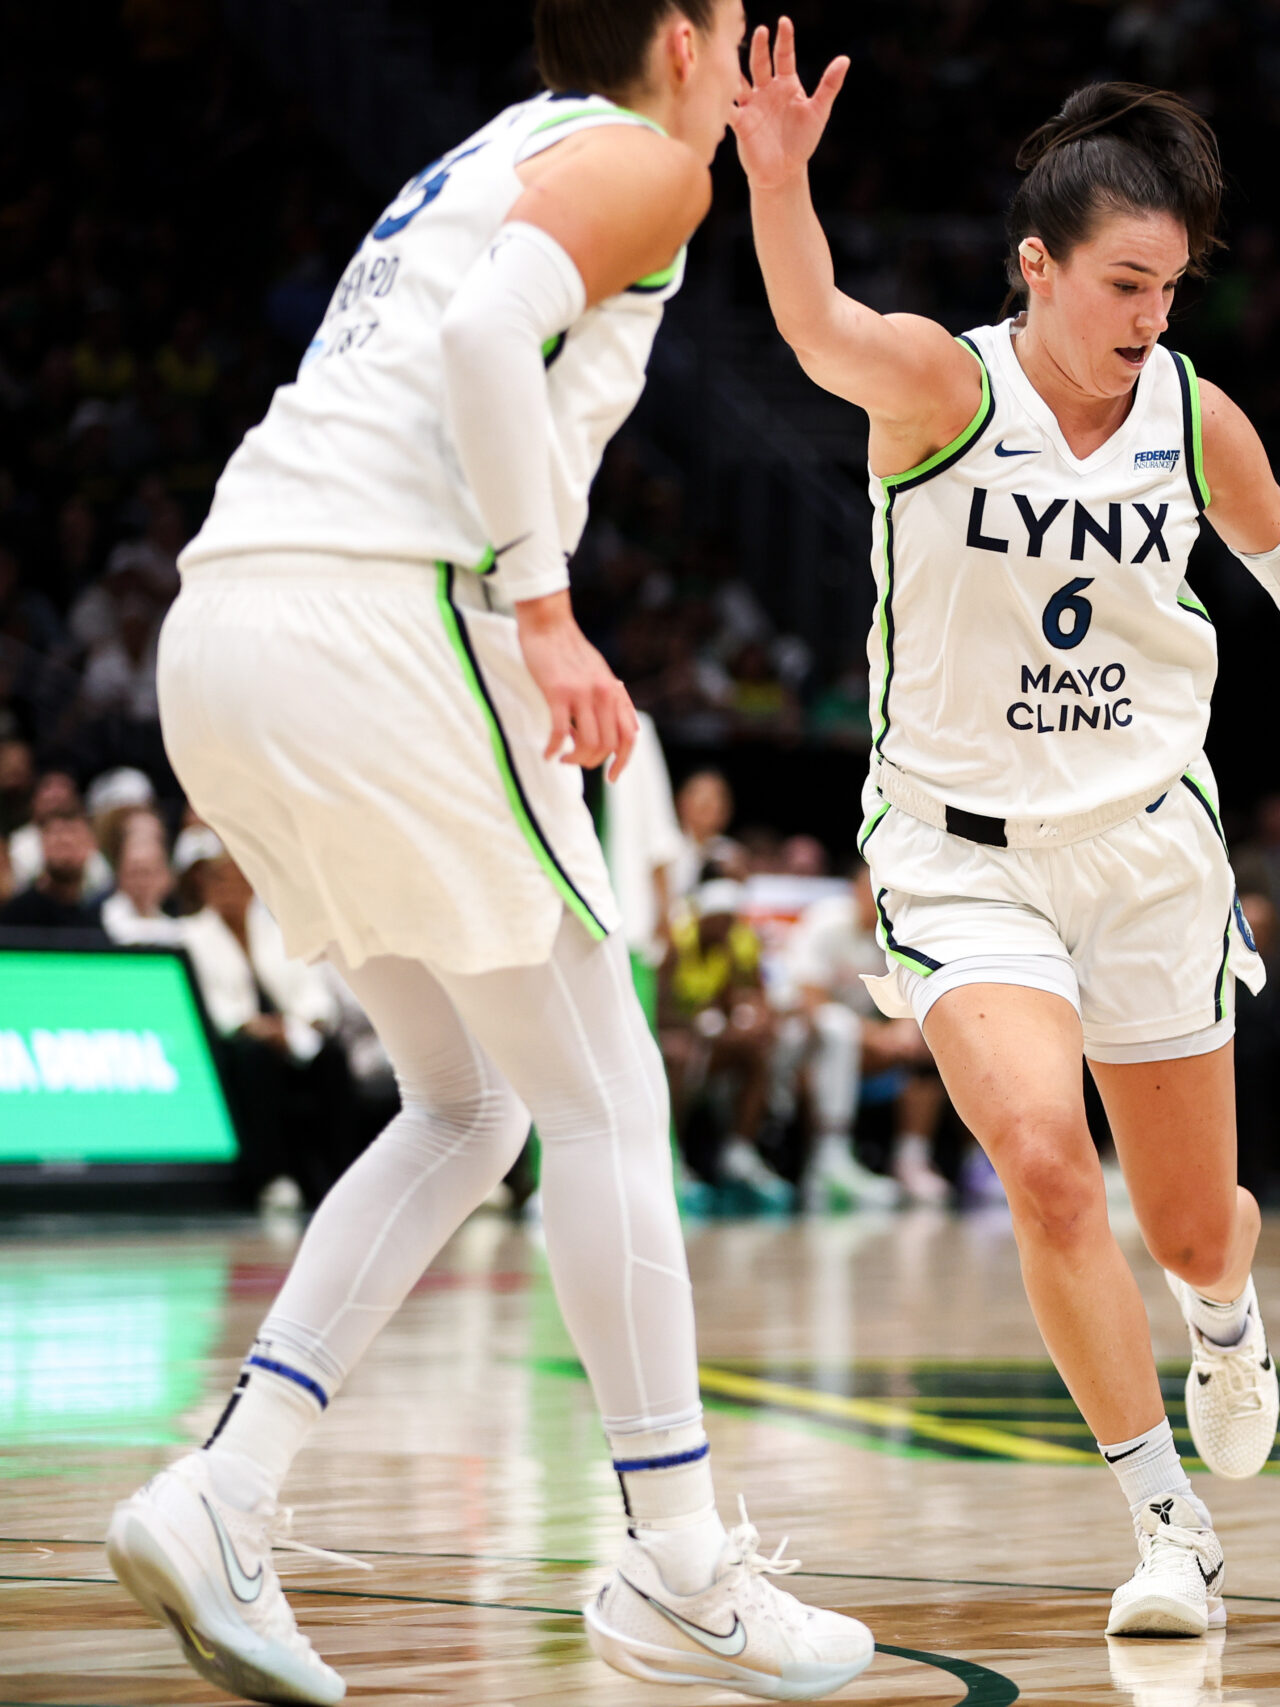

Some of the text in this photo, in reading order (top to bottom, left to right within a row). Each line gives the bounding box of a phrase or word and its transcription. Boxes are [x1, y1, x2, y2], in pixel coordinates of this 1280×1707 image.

[966, 486, 1171, 564] LYNX
[1042, 576, 1095, 650] 6
[1020, 662, 1126, 698] MAYO
[1006, 697, 1133, 734] CLINIC
